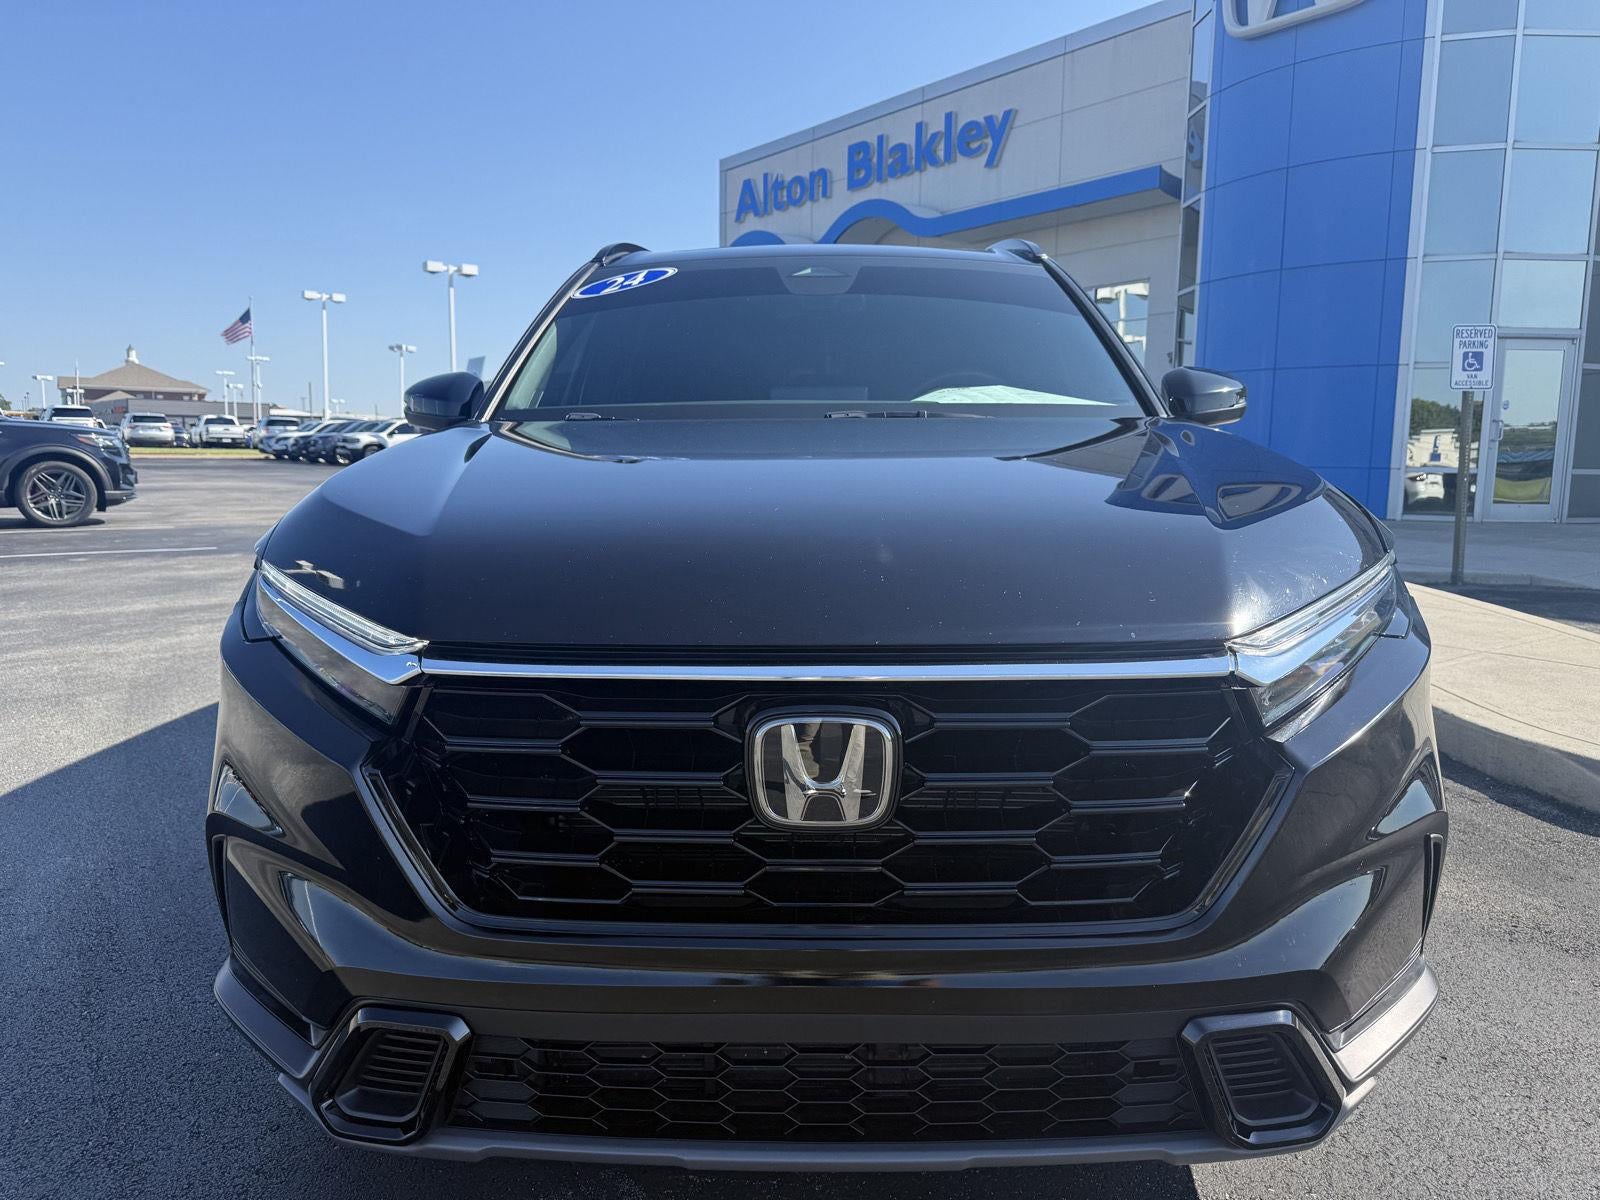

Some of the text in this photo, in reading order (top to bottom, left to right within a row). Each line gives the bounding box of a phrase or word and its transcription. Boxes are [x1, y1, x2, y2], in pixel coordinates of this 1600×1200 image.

[735, 107, 1018, 224] Alton Blakley
[601, 270, 648, 294] 24
[1456, 328, 1493, 339] RESERVED
[1459, 339, 1489, 349] PARKING
